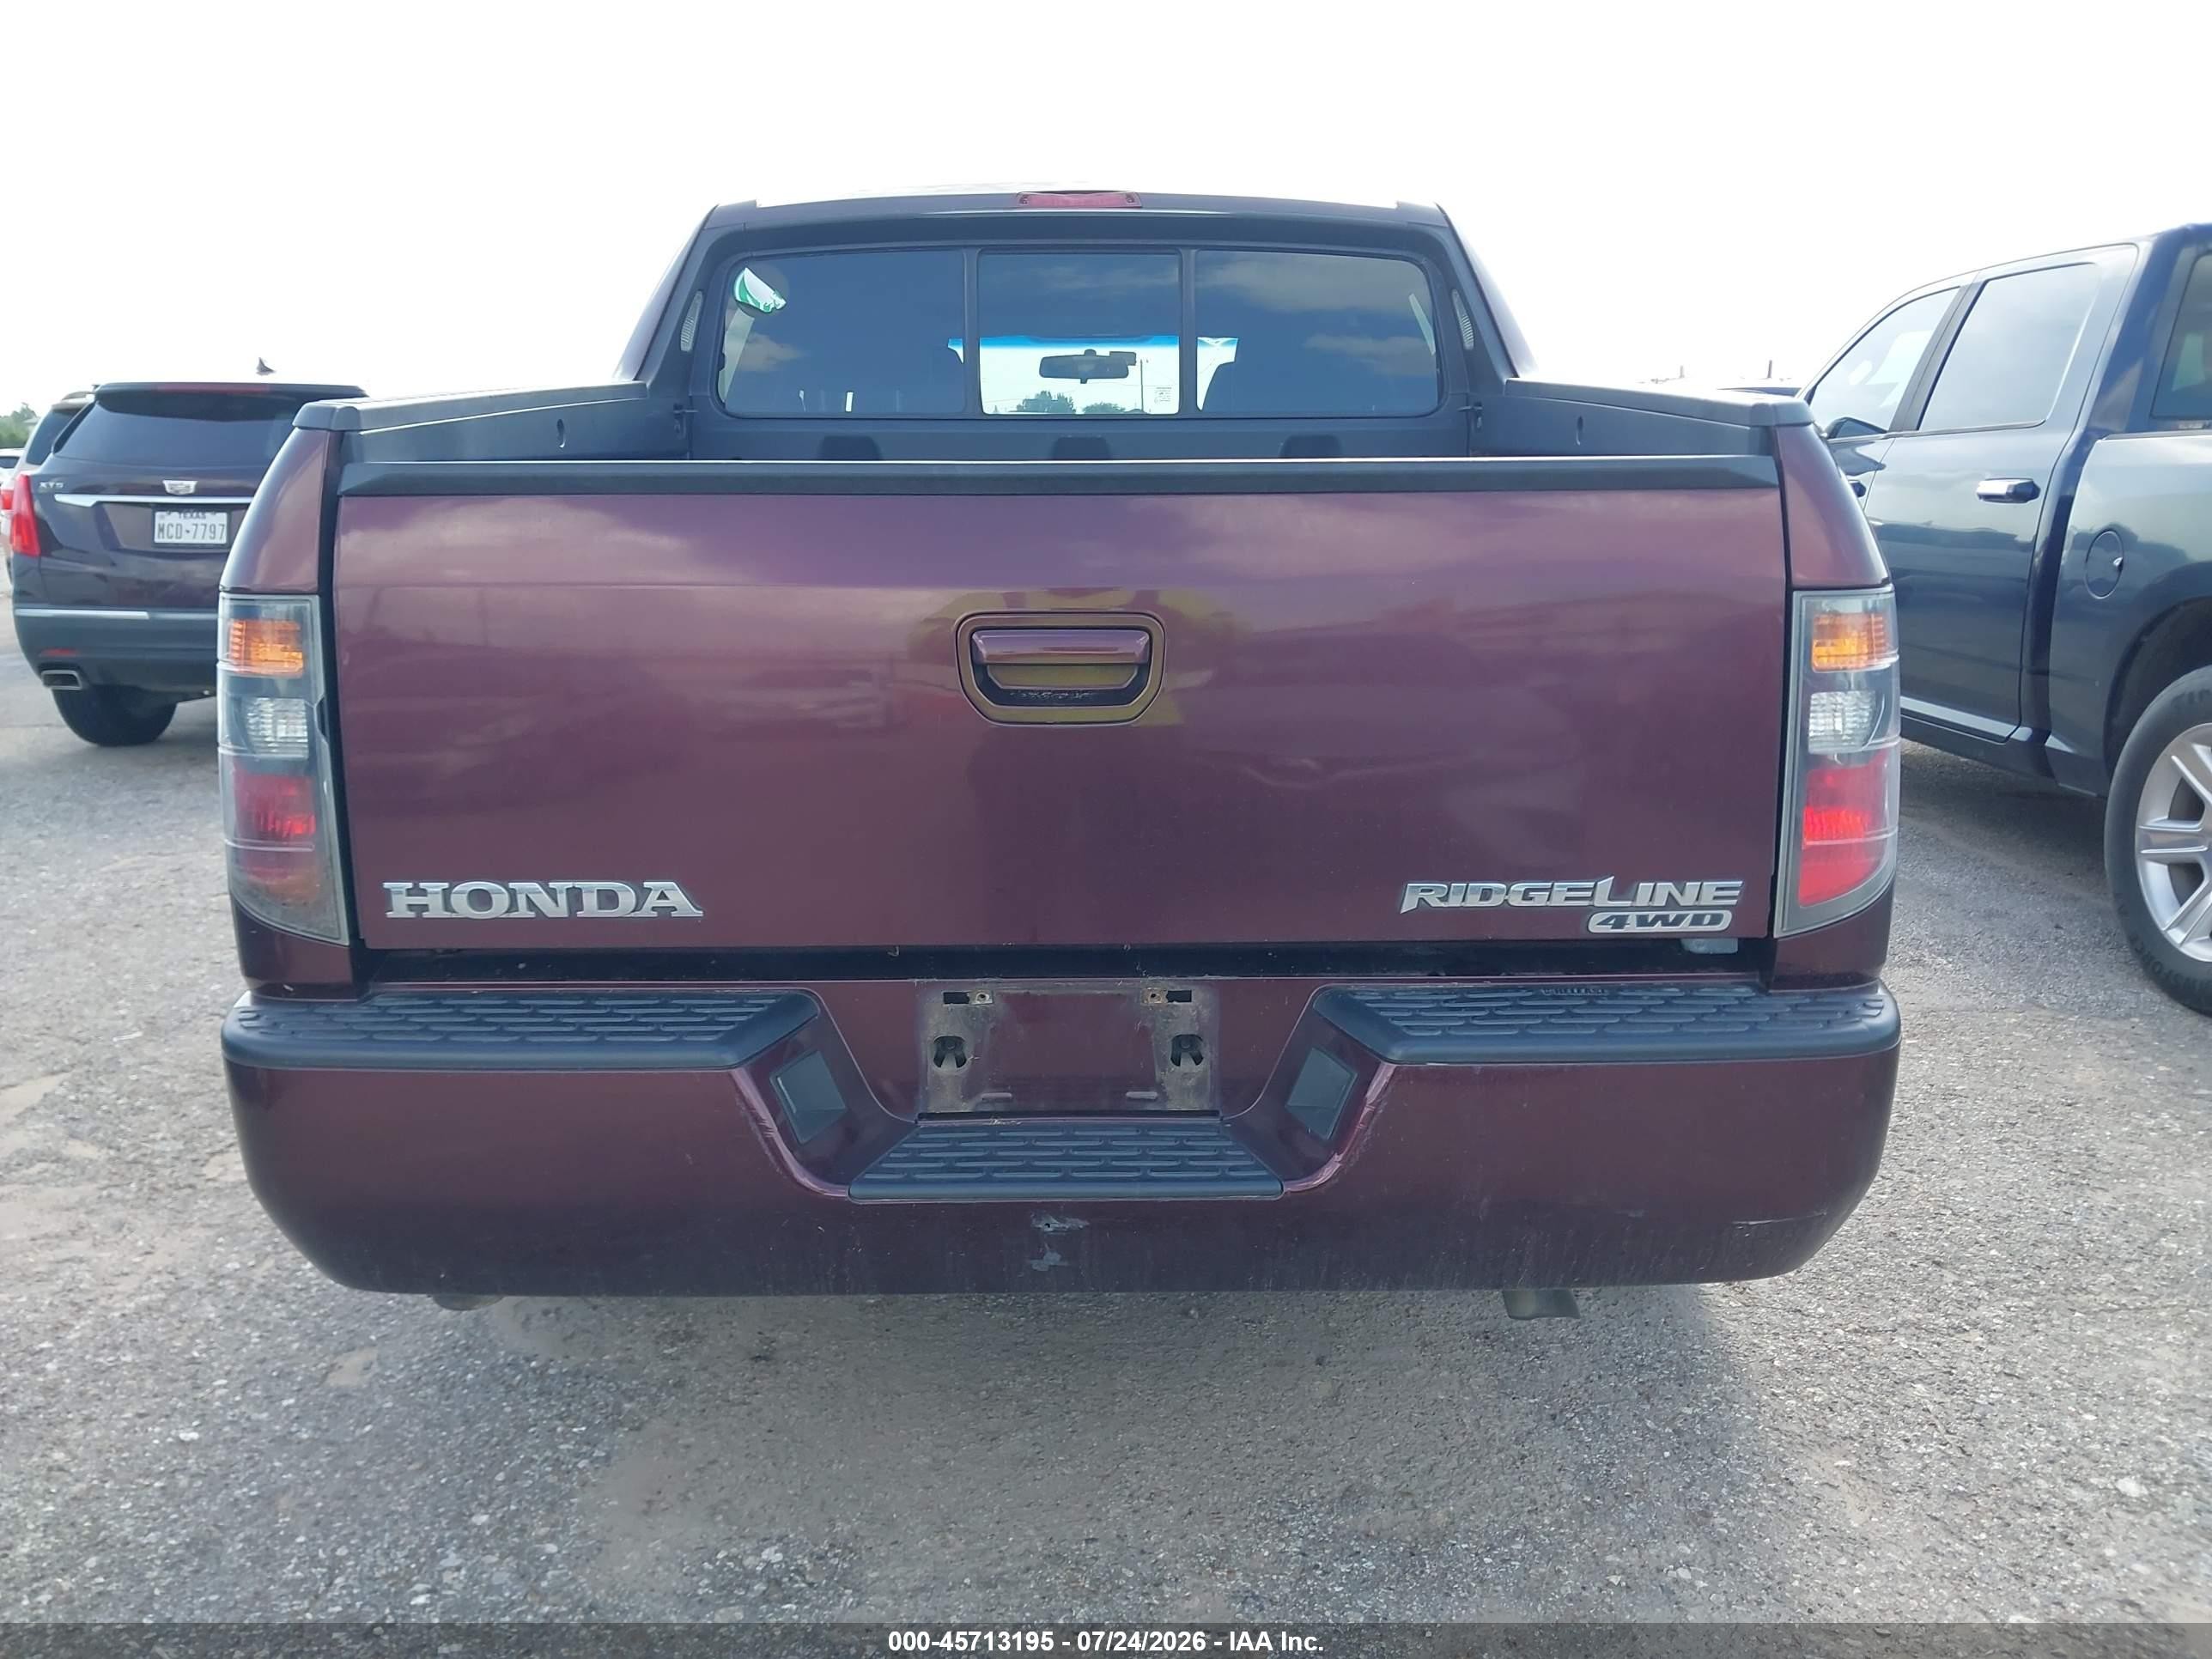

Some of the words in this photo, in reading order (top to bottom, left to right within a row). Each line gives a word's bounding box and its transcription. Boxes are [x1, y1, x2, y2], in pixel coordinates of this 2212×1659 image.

[383, 881, 703, 919] HONDA
[1400, 876, 1743, 914] RIDGELINE
[1595, 913, 1722, 930] 4WD
